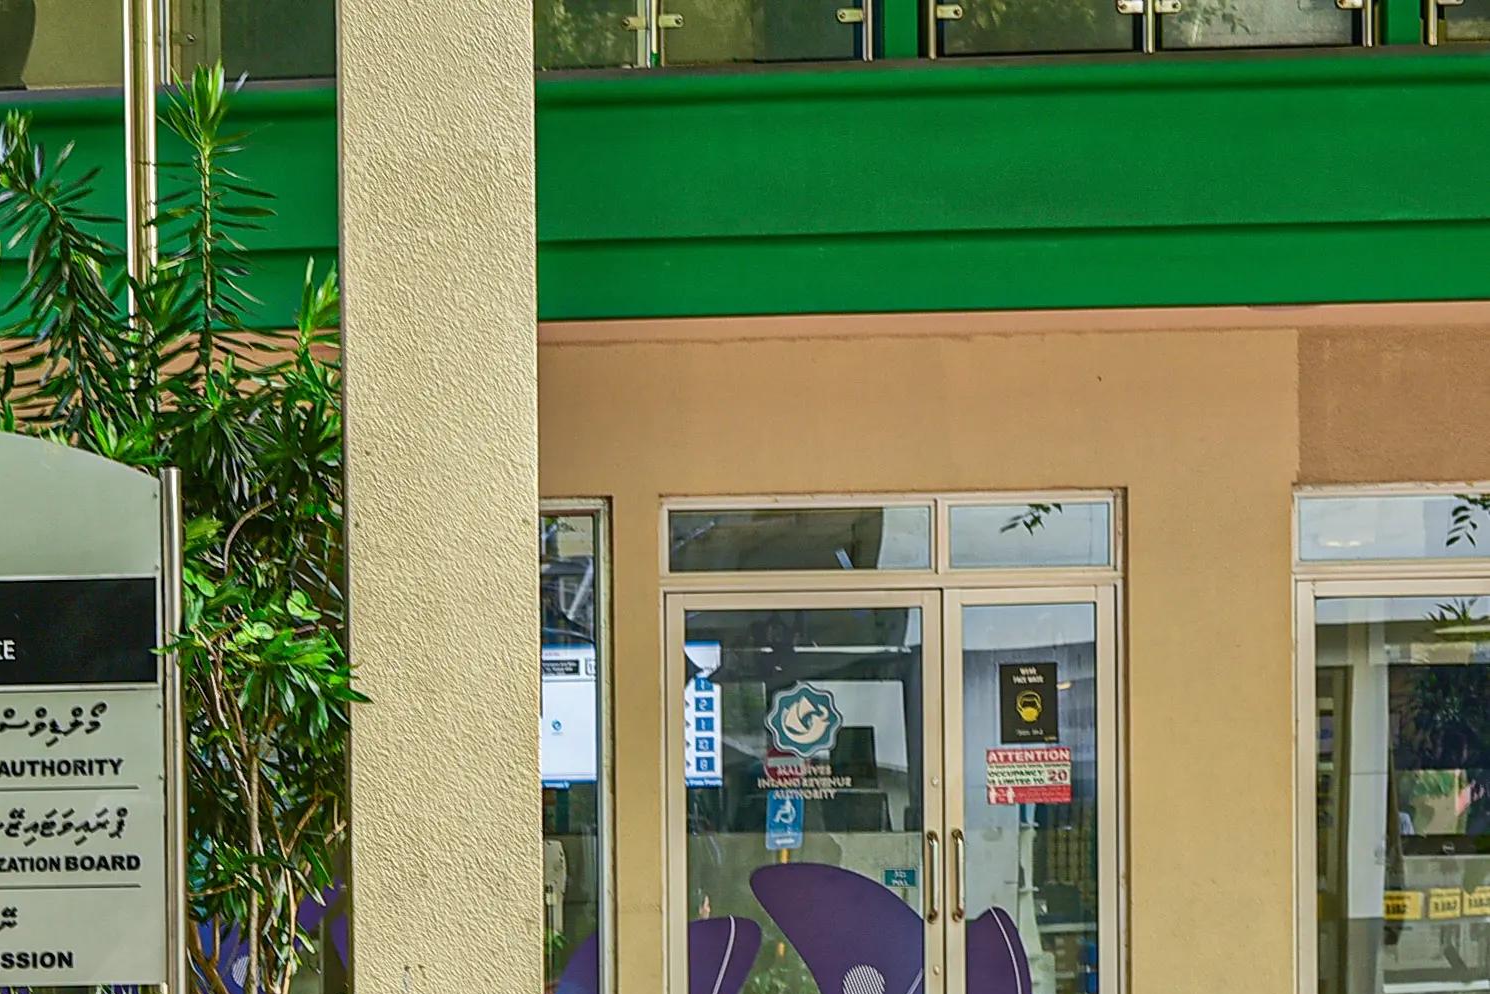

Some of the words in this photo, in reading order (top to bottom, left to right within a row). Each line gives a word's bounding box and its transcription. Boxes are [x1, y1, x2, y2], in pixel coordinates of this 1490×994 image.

[988, 750, 1070, 763] ATTENTION
[757, 777, 801, 788] INLAND
[802, 776, 852, 788] REVENUE
[1048, 769, 1068, 782] 20
[64, 855, 141, 872] BOARD
